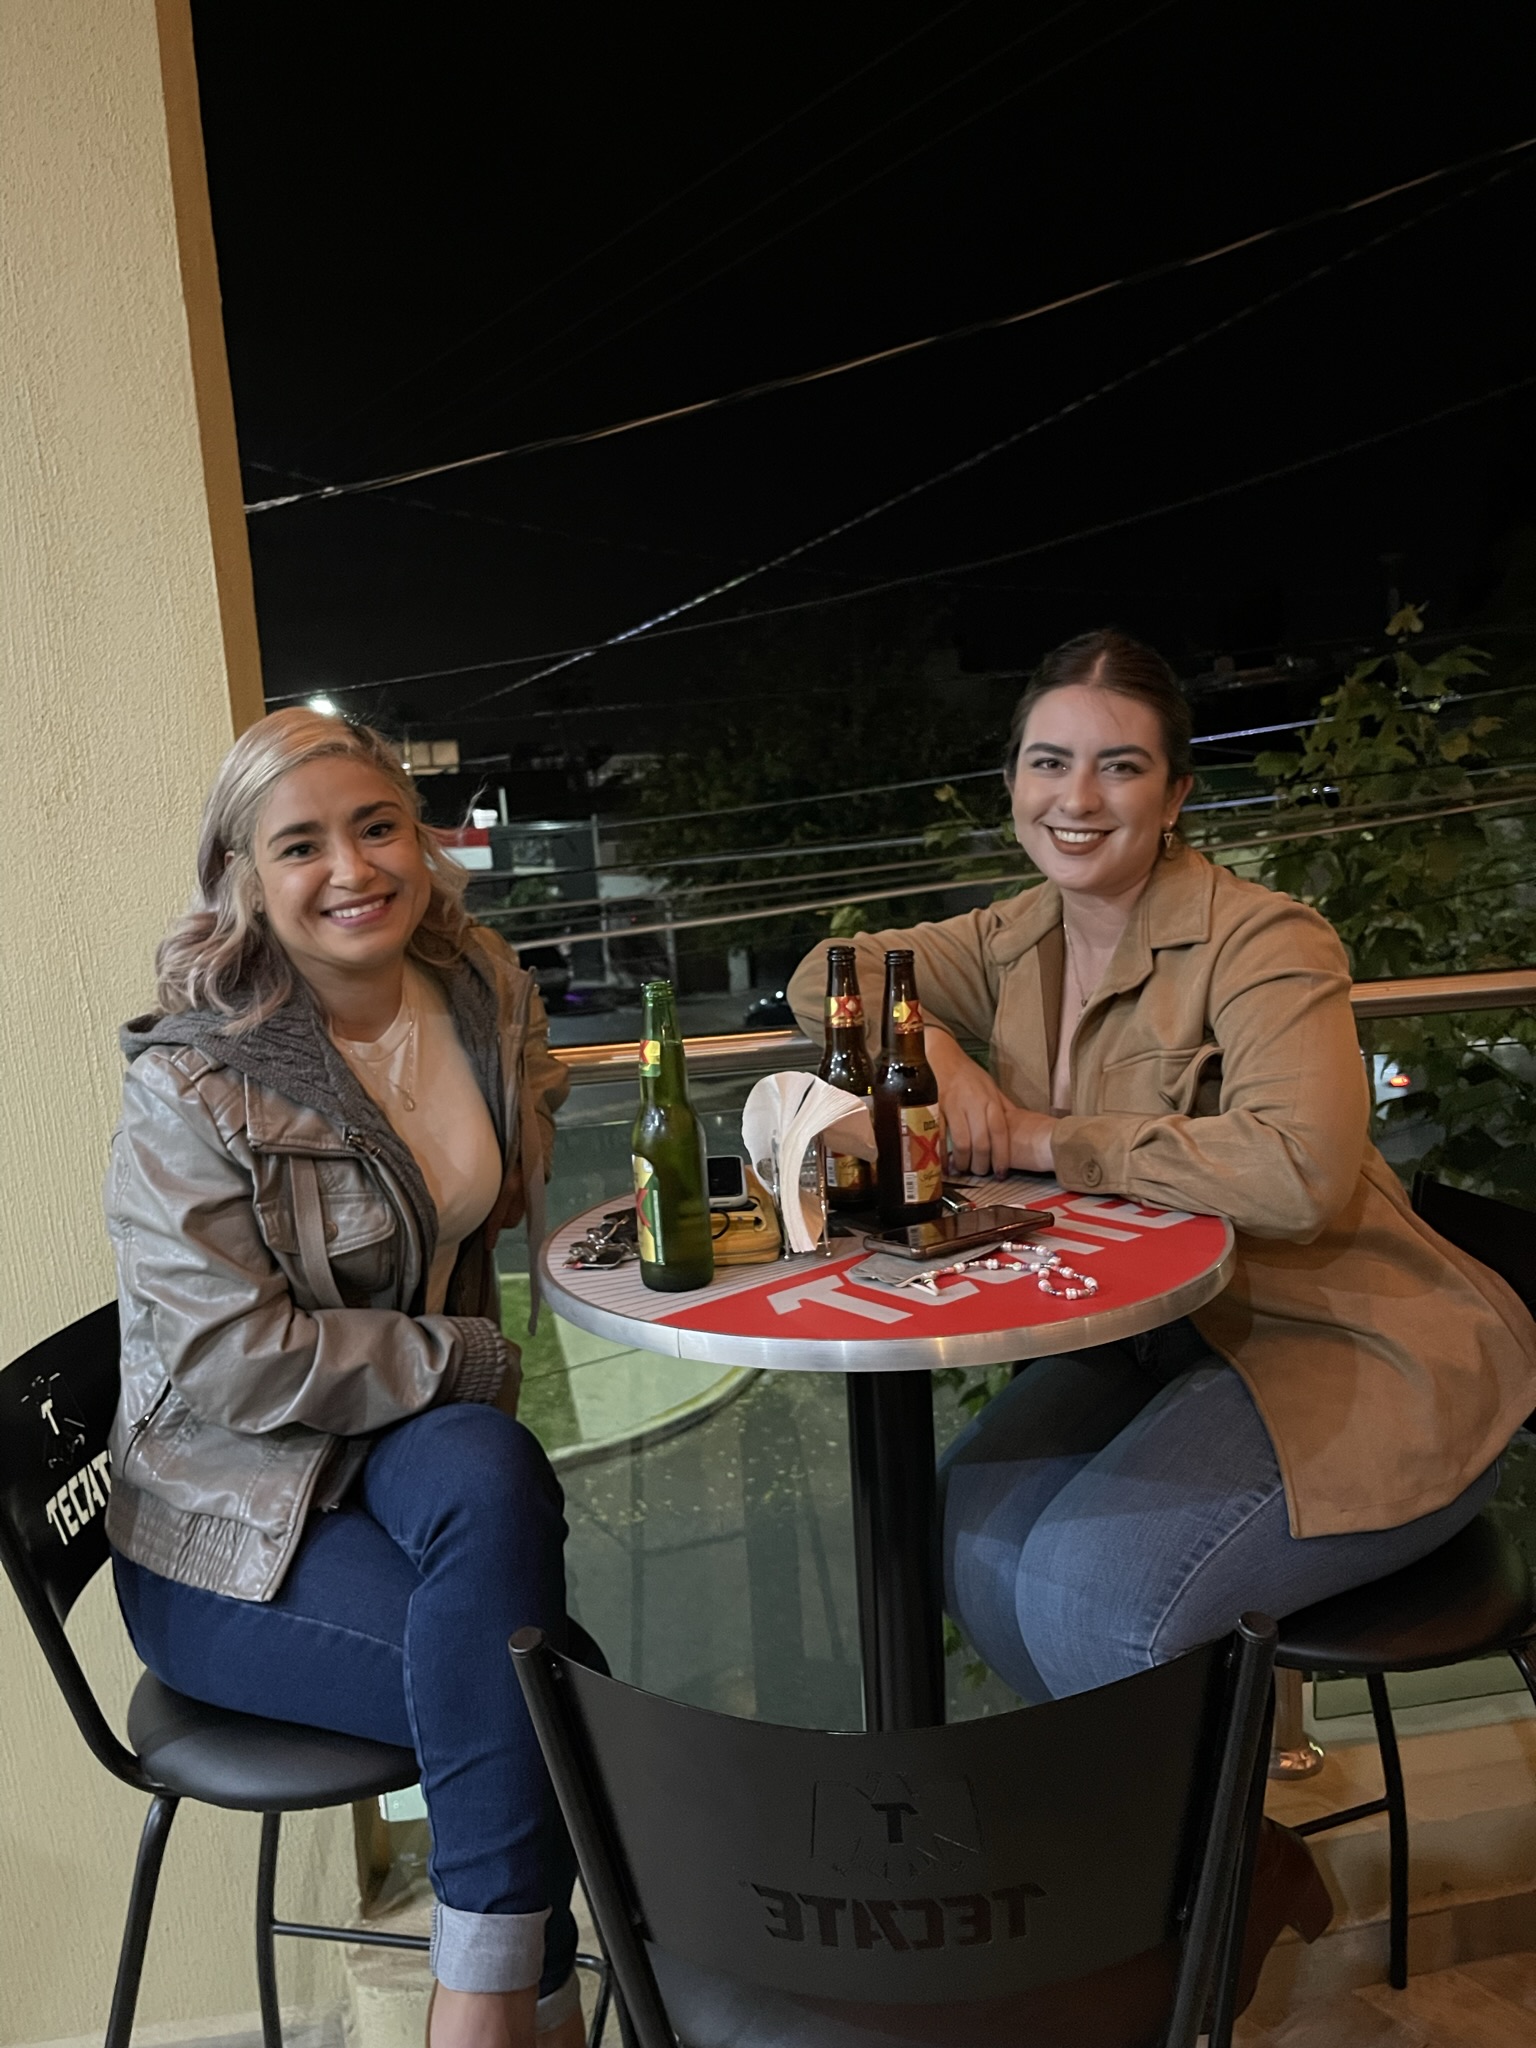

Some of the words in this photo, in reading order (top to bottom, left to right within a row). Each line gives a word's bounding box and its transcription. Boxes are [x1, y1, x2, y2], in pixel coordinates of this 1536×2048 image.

[41, 1398, 60, 1435] T
[45, 1450, 113, 1546] TECAT
[870, 1802, 919, 1845] T
